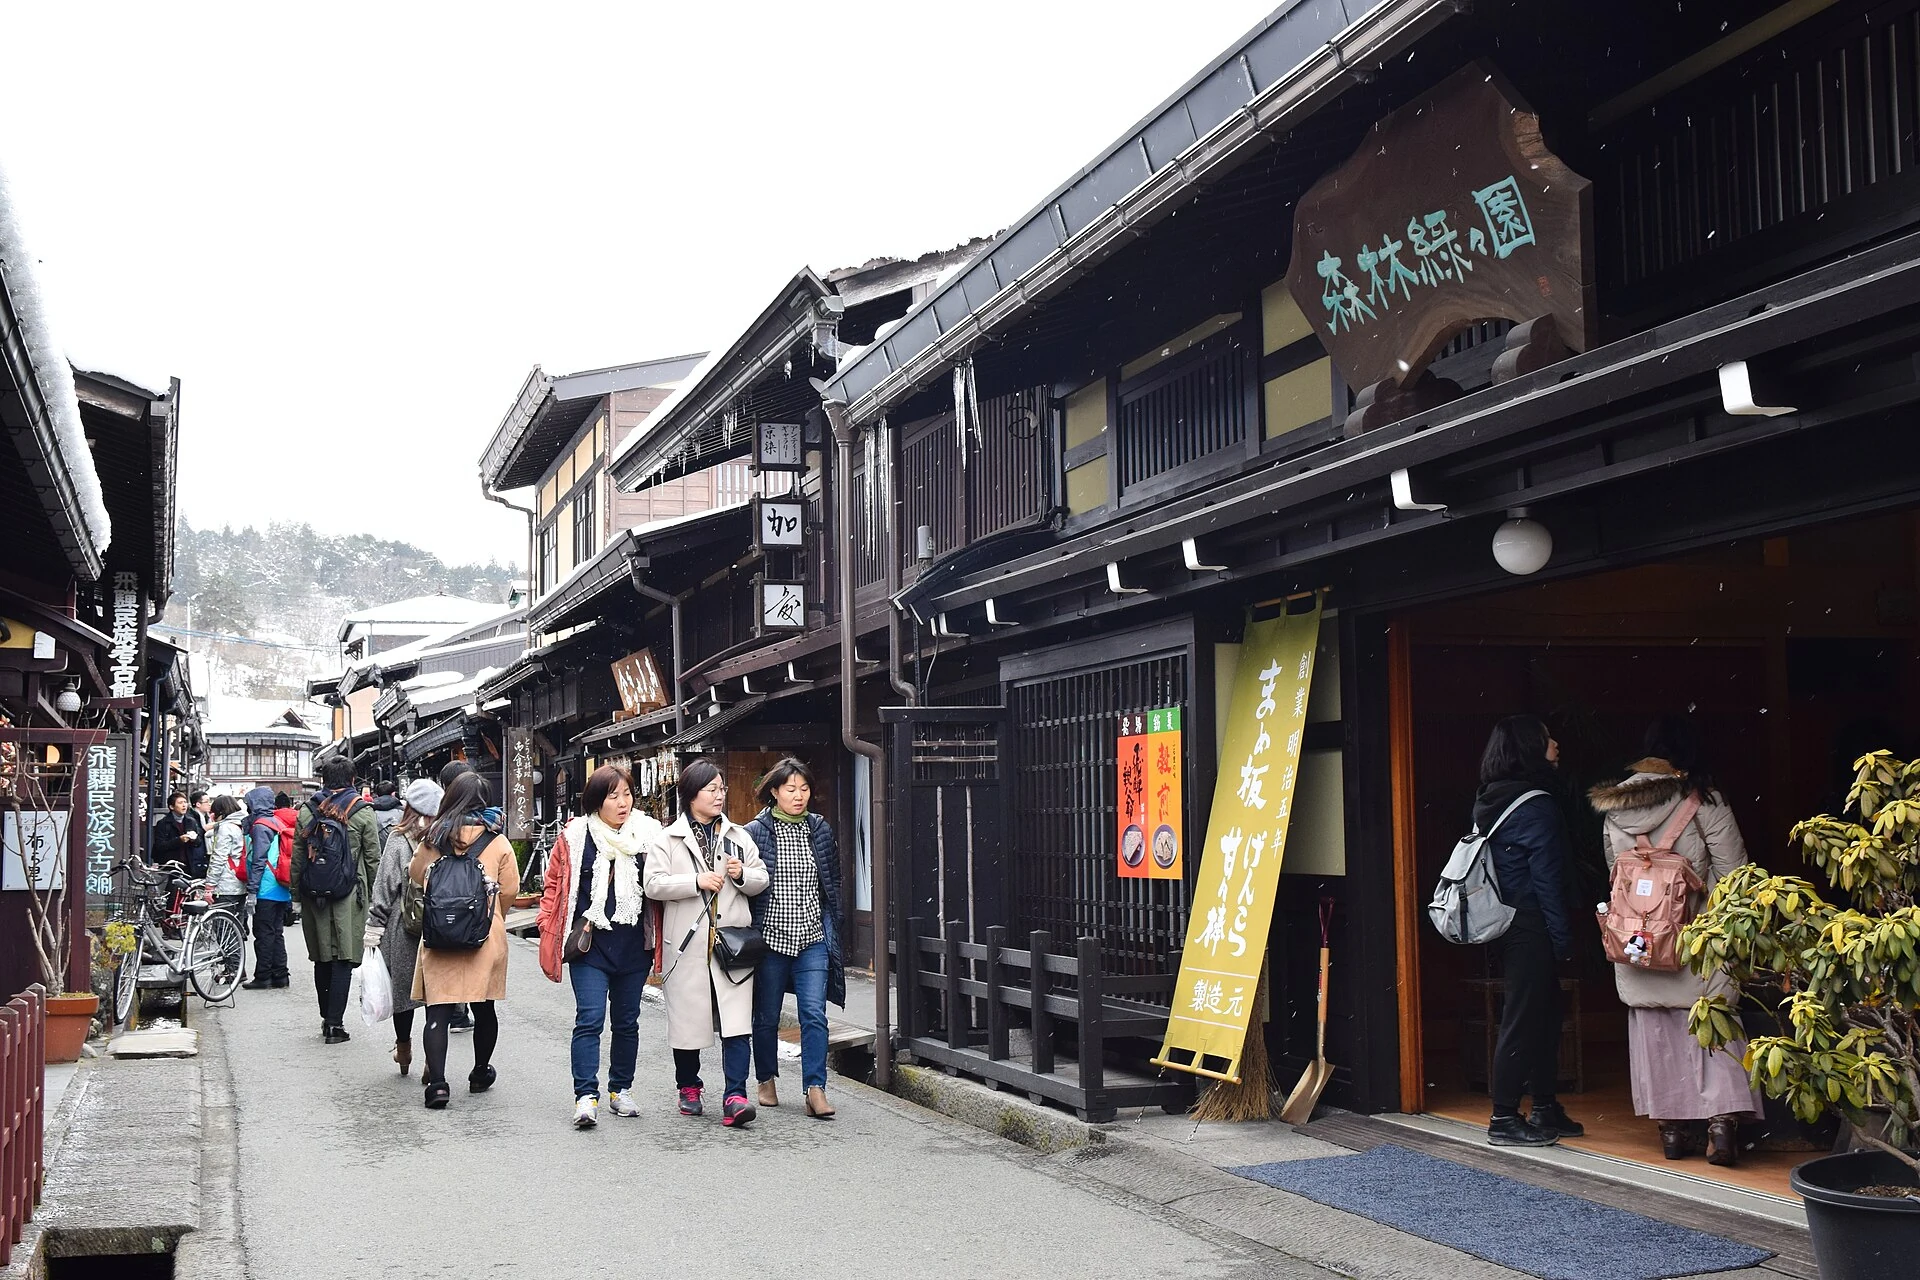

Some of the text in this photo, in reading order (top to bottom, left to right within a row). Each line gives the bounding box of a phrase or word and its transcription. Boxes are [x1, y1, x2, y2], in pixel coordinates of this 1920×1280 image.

[1317, 175, 1537, 336] 森林緑々園
[767, 508, 797, 538] 加
[1237, 658, 1282, 810] まめ板
[1194, 826, 1243, 957] 甘々棒
[1228, 830, 1268, 957] げんこつ
[1188, 978, 1244, 1017] 製造元
